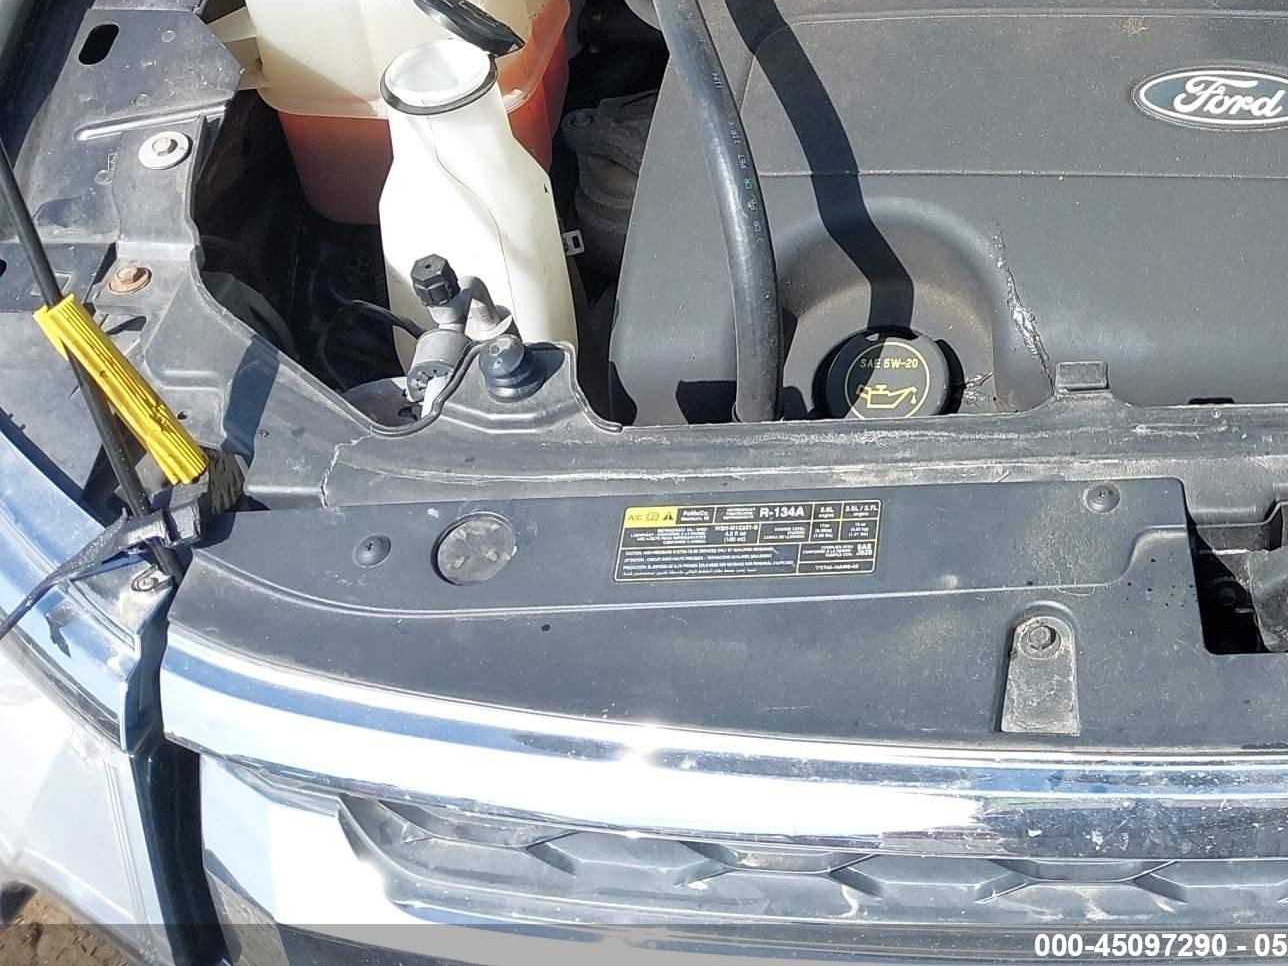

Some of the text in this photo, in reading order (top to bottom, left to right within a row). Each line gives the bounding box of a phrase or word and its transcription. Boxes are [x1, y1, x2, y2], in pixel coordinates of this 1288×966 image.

[1173, 75, 1286, 117] Ford
[859, 358, 919, 369] SAE 5W-20
[759, 505, 805, 518] R-134A
[627, 514, 643, 522] A/C
